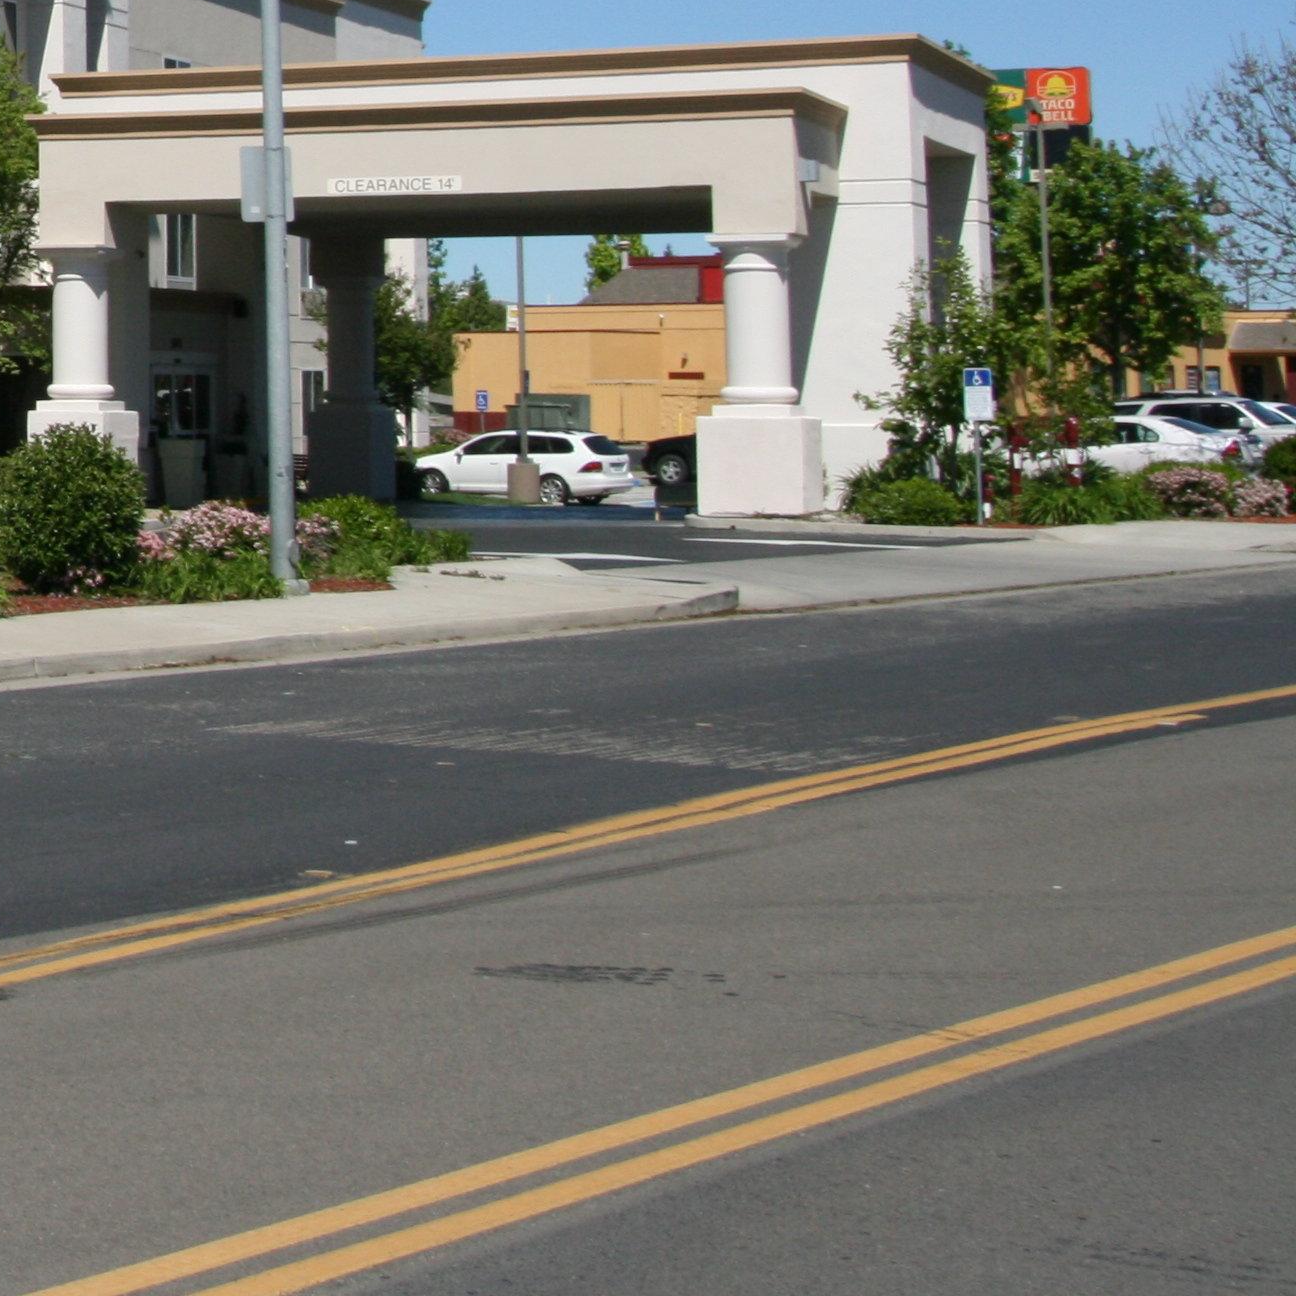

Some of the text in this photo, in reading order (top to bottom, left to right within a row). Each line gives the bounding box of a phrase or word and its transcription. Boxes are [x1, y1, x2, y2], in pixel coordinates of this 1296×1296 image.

[1040, 99, 1075, 110] TACO
[1041, 111, 1074, 121] BELL
[334, 177, 432, 193] CLEARANCE
